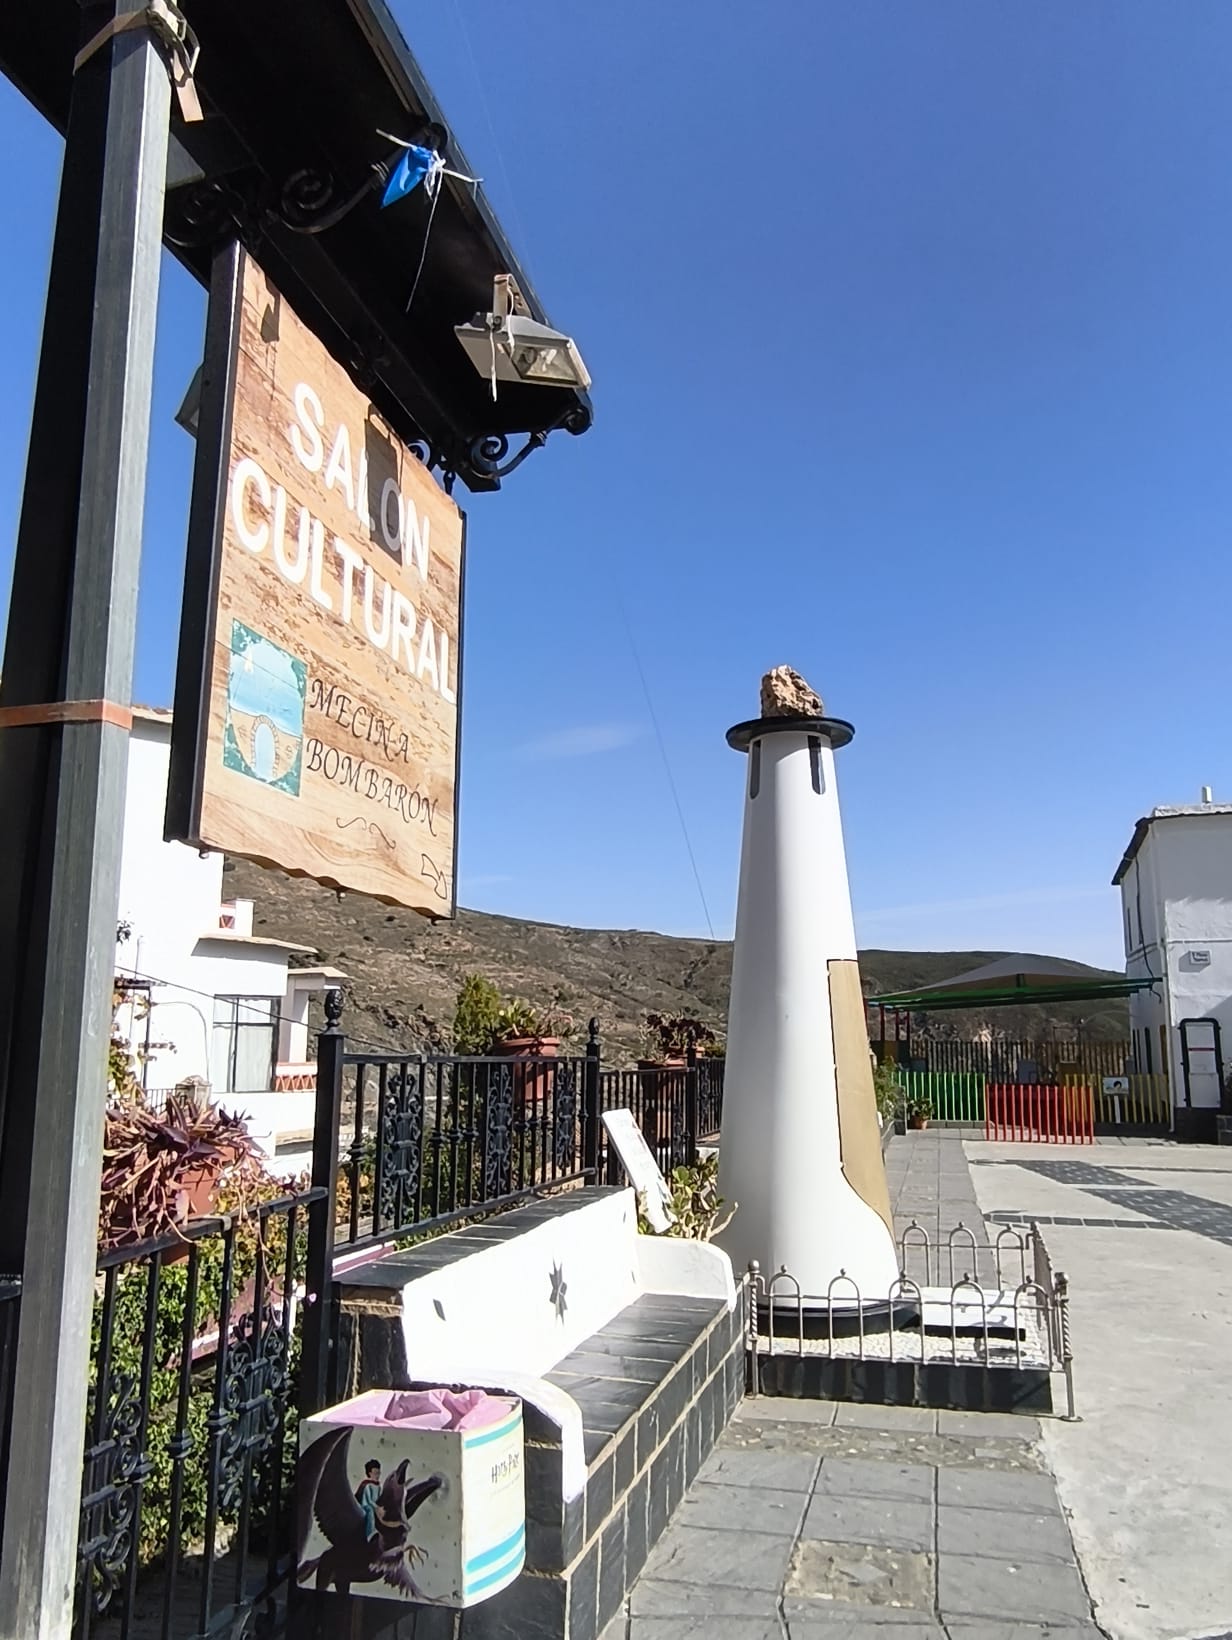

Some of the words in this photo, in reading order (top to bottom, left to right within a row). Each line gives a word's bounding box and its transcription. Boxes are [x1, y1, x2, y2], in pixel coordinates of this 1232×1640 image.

[291, 382, 430, 582] SALON
[230, 457, 457, 705] CULTURAL
[306, 738, 439, 837] BOMBARÓN
[309, 678, 409, 763] MECINA
